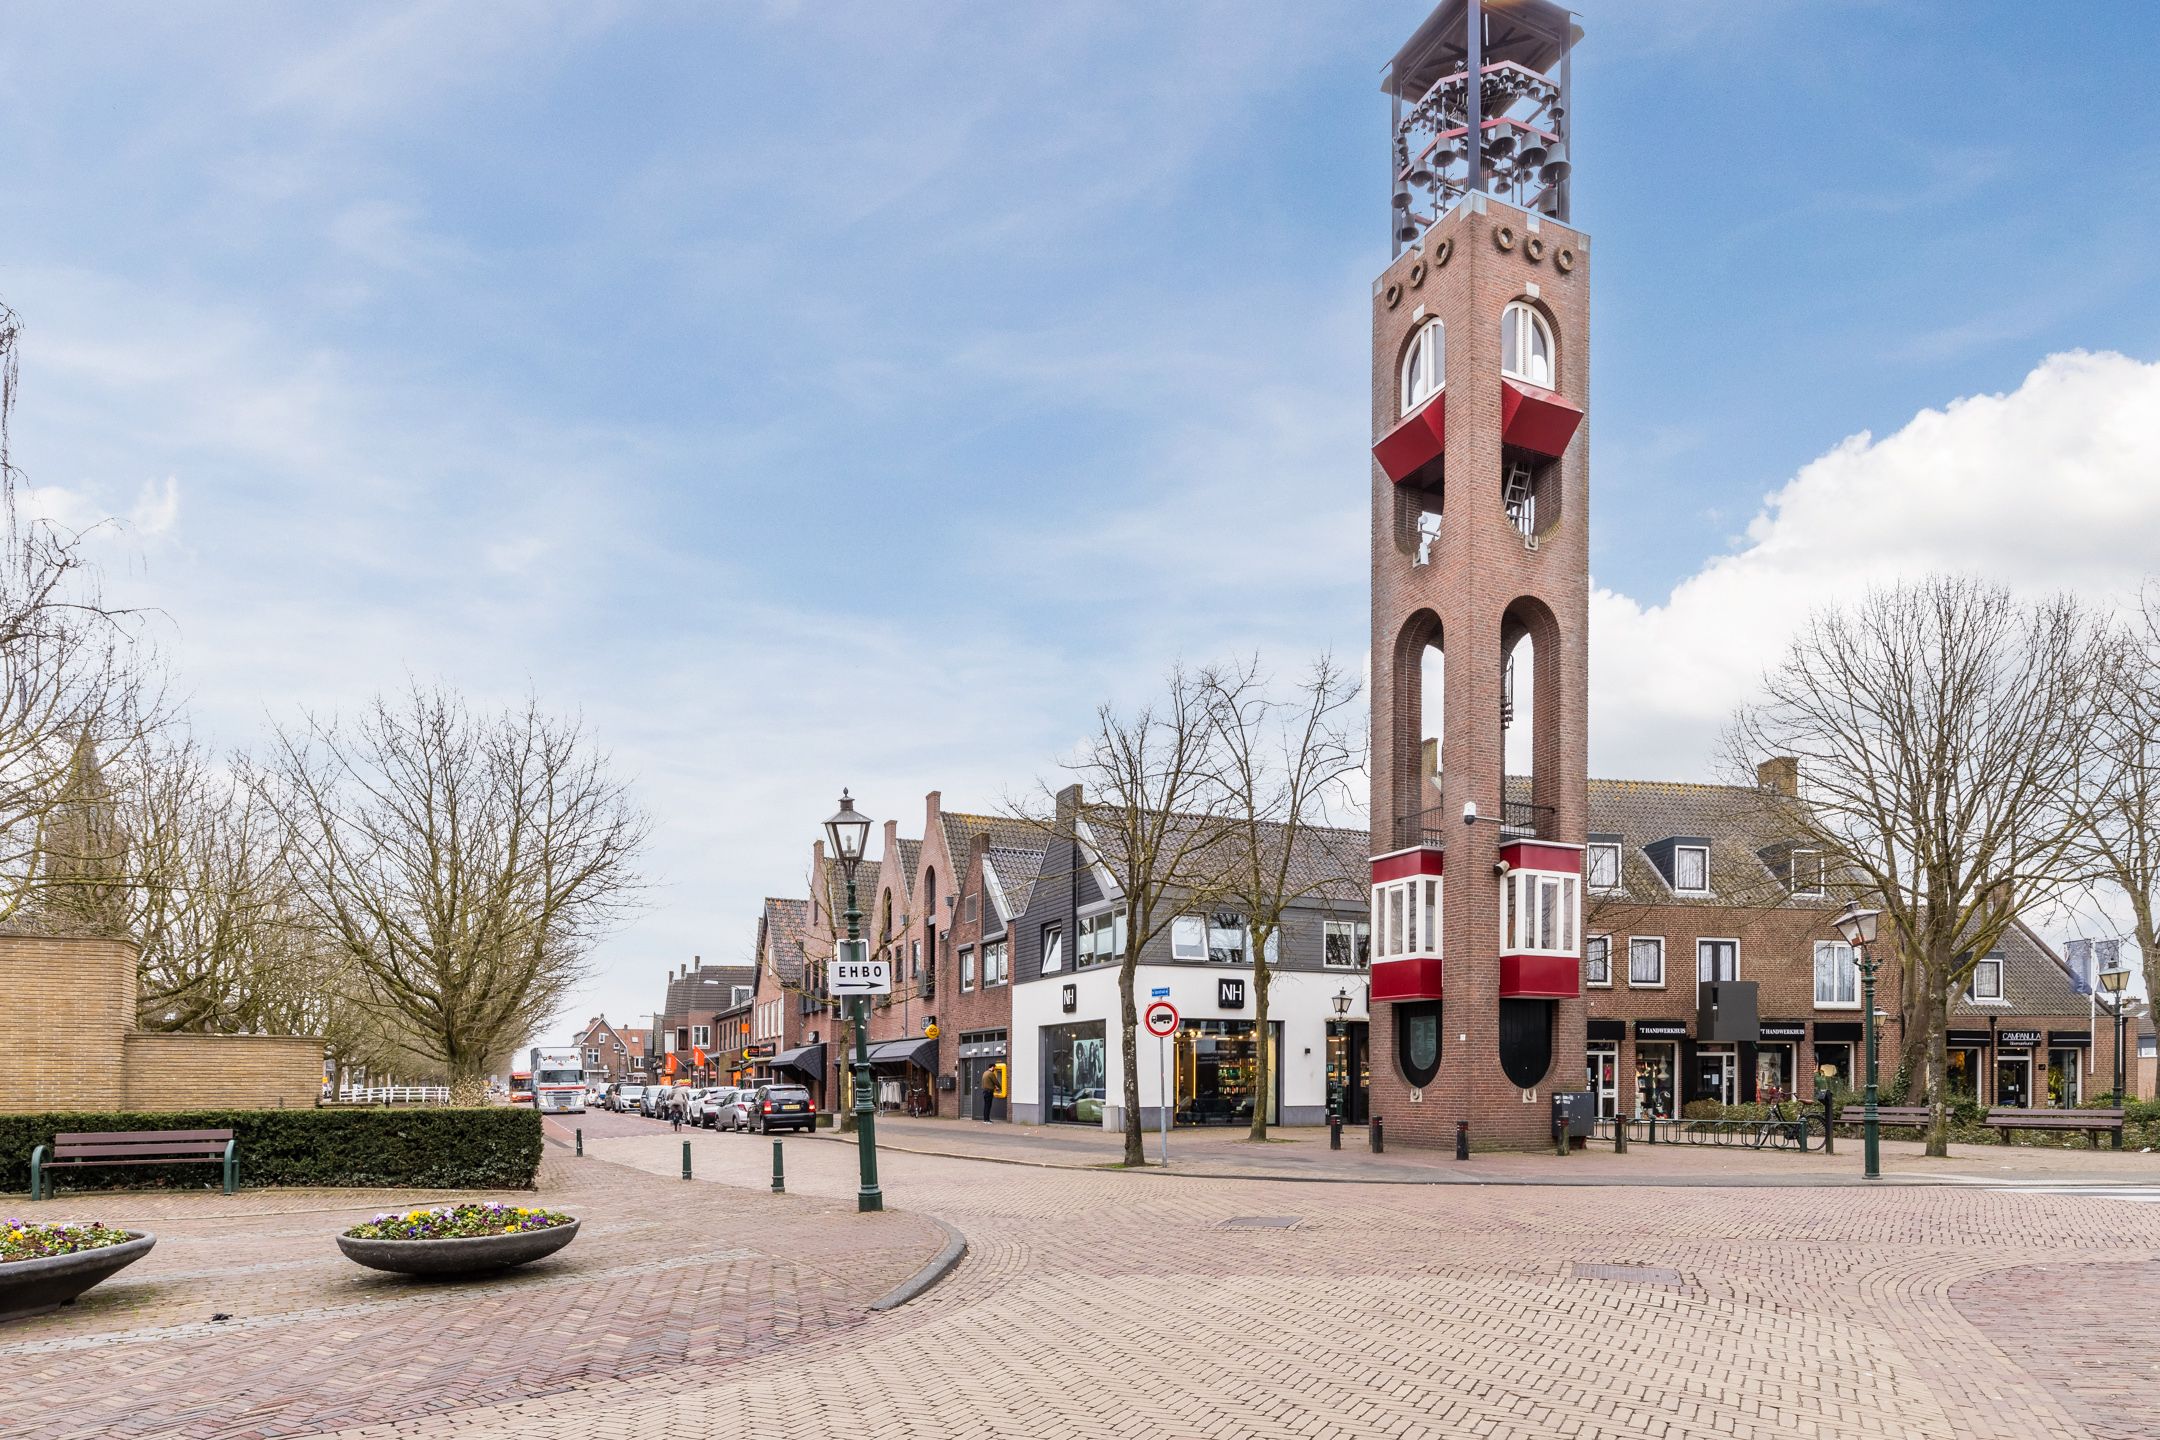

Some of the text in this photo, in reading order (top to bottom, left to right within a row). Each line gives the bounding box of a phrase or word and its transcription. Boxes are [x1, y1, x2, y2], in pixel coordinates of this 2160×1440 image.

[839, 966, 882, 977] EHBO
[1063, 989, 1074, 1005] NH
[1222, 984, 1242, 1001] NH
[2002, 1032, 2041, 1040] CAMPANULA
